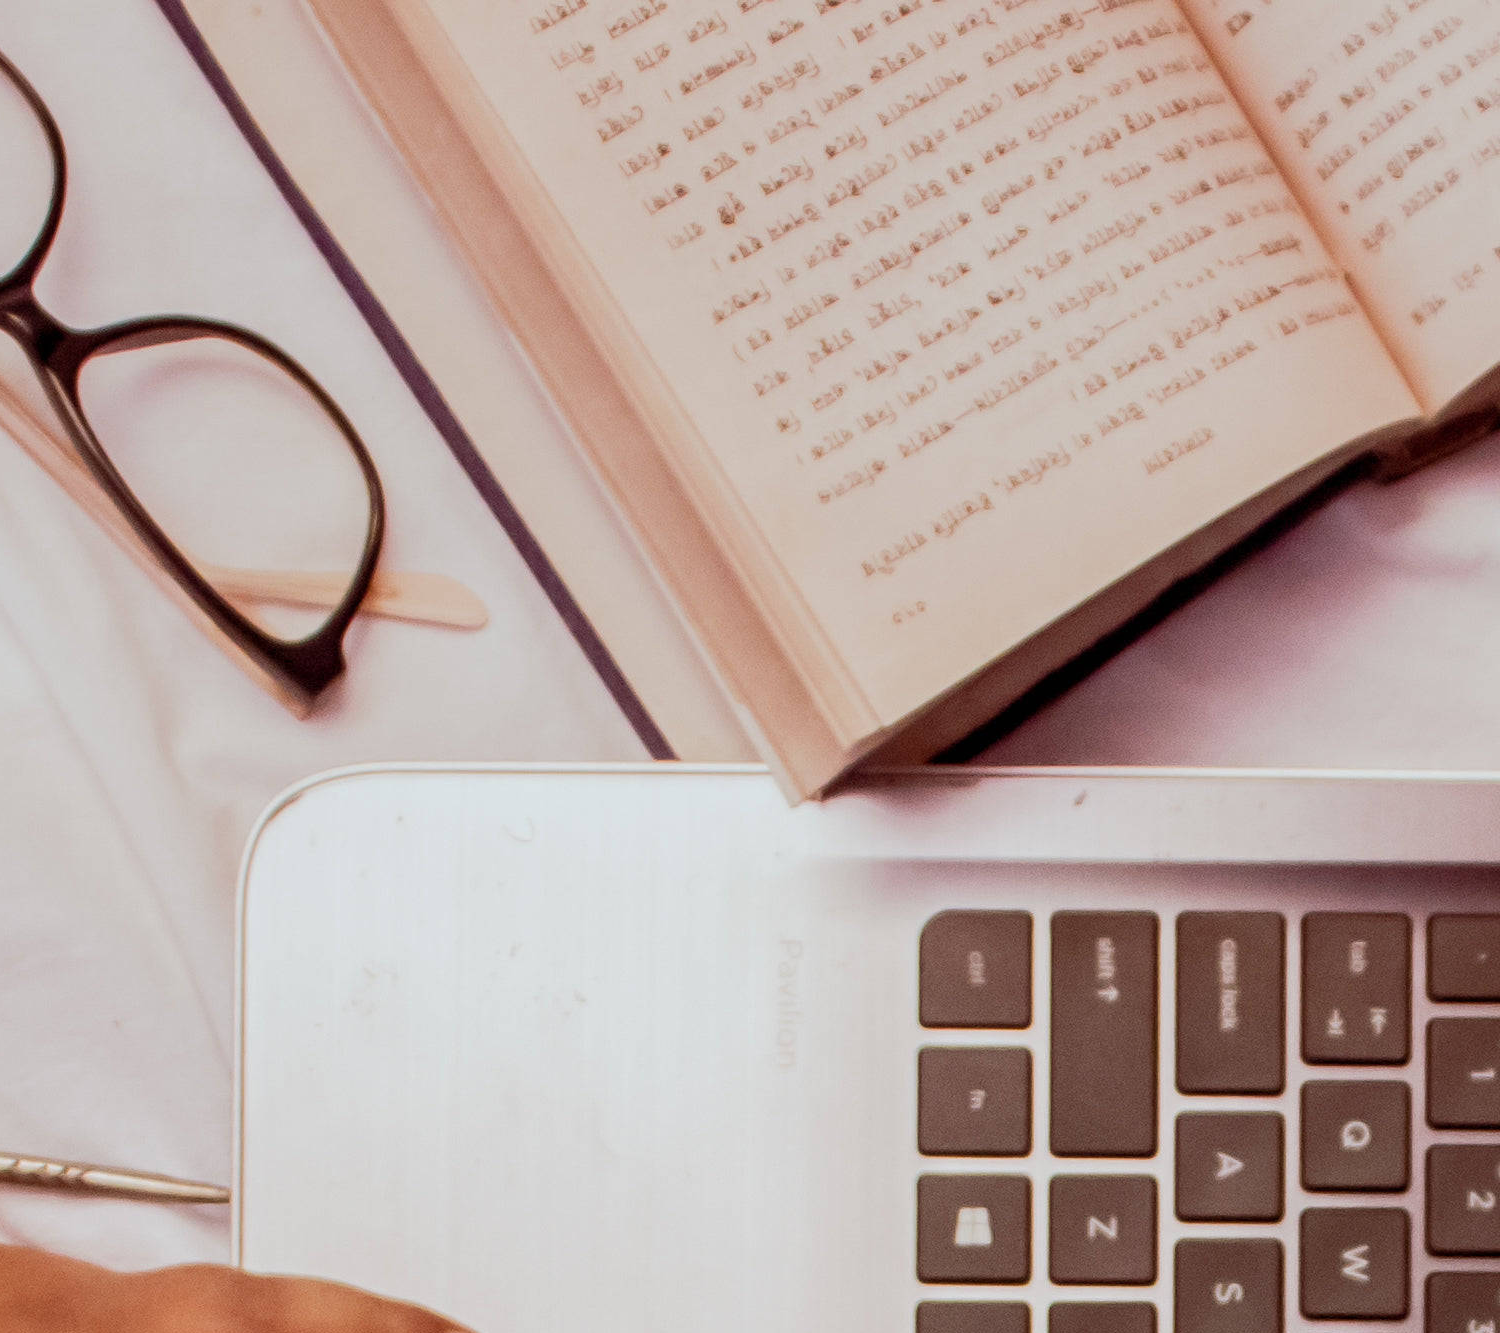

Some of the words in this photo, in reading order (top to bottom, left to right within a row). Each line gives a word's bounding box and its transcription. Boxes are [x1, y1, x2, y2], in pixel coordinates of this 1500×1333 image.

[773, 938, 804, 1072] Pavilion
[1338, 1118, 1372, 1152] Q
[1214, 1150, 1244, 1180] A
[1466, 1189, 1496, 1212] 2
[1085, 1214, 1118, 1240] Z
[1340, 1243, 1370, 1283] W
[1212, 1280, 1244, 1306] S
